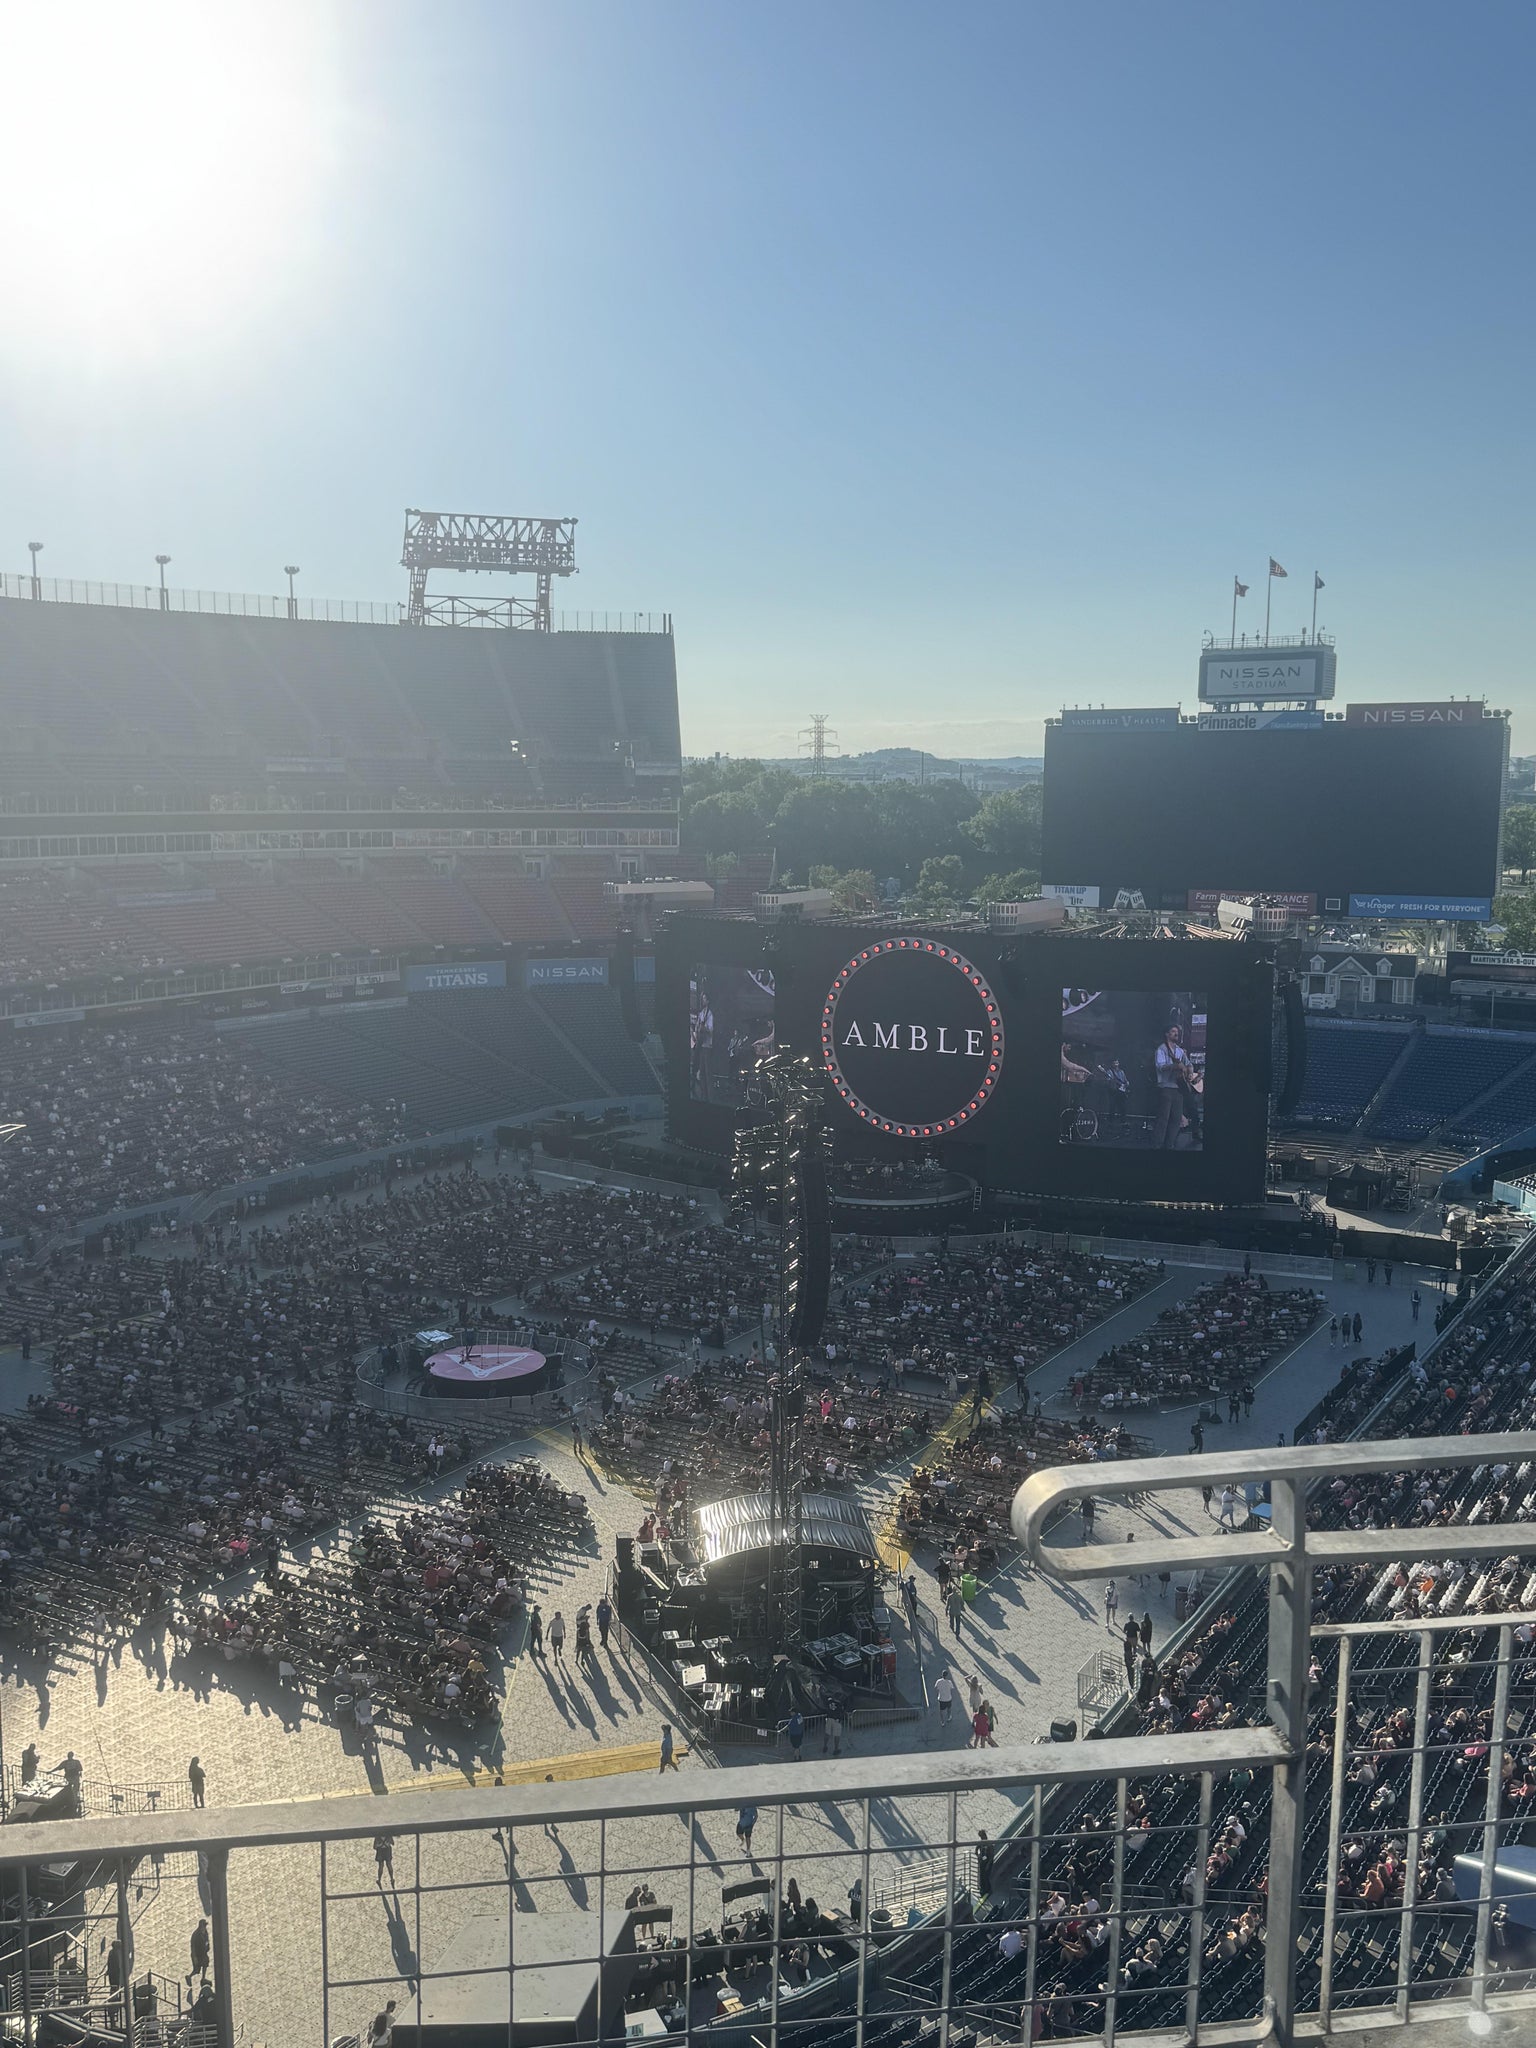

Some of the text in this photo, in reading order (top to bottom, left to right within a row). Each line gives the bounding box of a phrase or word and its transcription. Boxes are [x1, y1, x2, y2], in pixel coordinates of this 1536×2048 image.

[1220, 666, 1301, 679] NISSAN
[1232, 680, 1287, 689] STADIUM
[1071, 718, 1119, 726] VANDERBILT
[1134, 717, 1166, 725] HEALTH
[1364, 709, 1463, 722] NISSAN
[1200, 715, 1256, 730] Pinnacle
[1054, 886, 1087, 895] TITAN UP
[1195, 892, 1217, 901] Farm
[1367, 898, 1396, 913] Kroger
[1400, 903, 1423, 911] FRESH
[1473, 956, 1501, 964] MARTIN'S
[436, 967, 476, 975] TENNESSEE
[532, 966, 604, 978] NISSAN
[425, 972, 489, 988] TITANS
[841, 1020, 985, 1057] AMBLE
